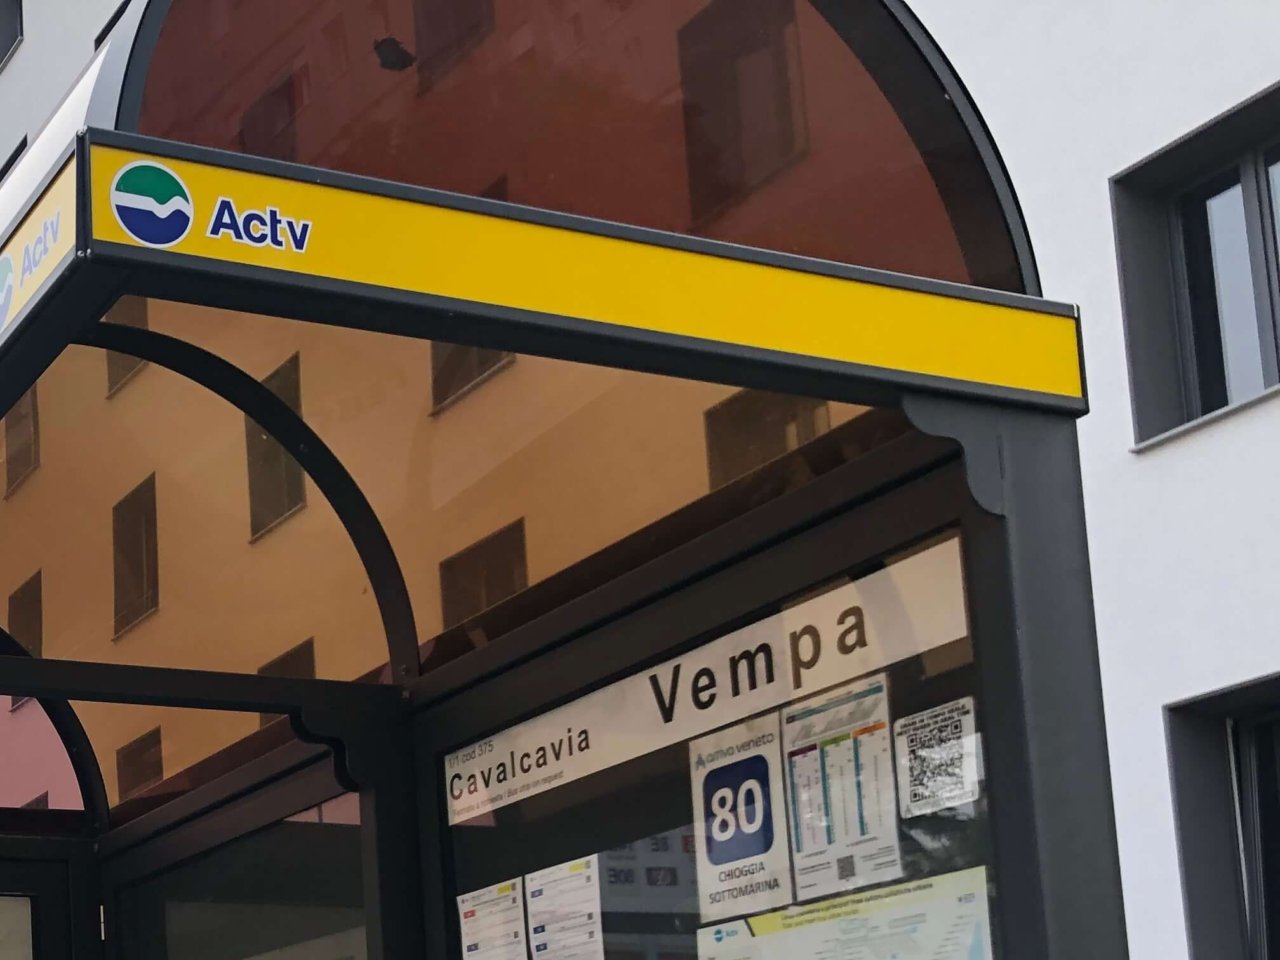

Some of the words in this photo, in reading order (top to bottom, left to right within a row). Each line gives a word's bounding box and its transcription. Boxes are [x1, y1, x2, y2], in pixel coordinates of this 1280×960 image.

[20, 208, 62, 287] Actv
[206, 198, 311, 253] Actv
[648, 604, 869, 725] Vempa
[449, 728, 591, 801] Cavalcavia
[735, 733, 774, 753] veneto
[710, 778, 764, 843] 80
[708, 878, 780, 905] SOTTOMARINA
[718, 861, 765, 883] CHIOGGIA
